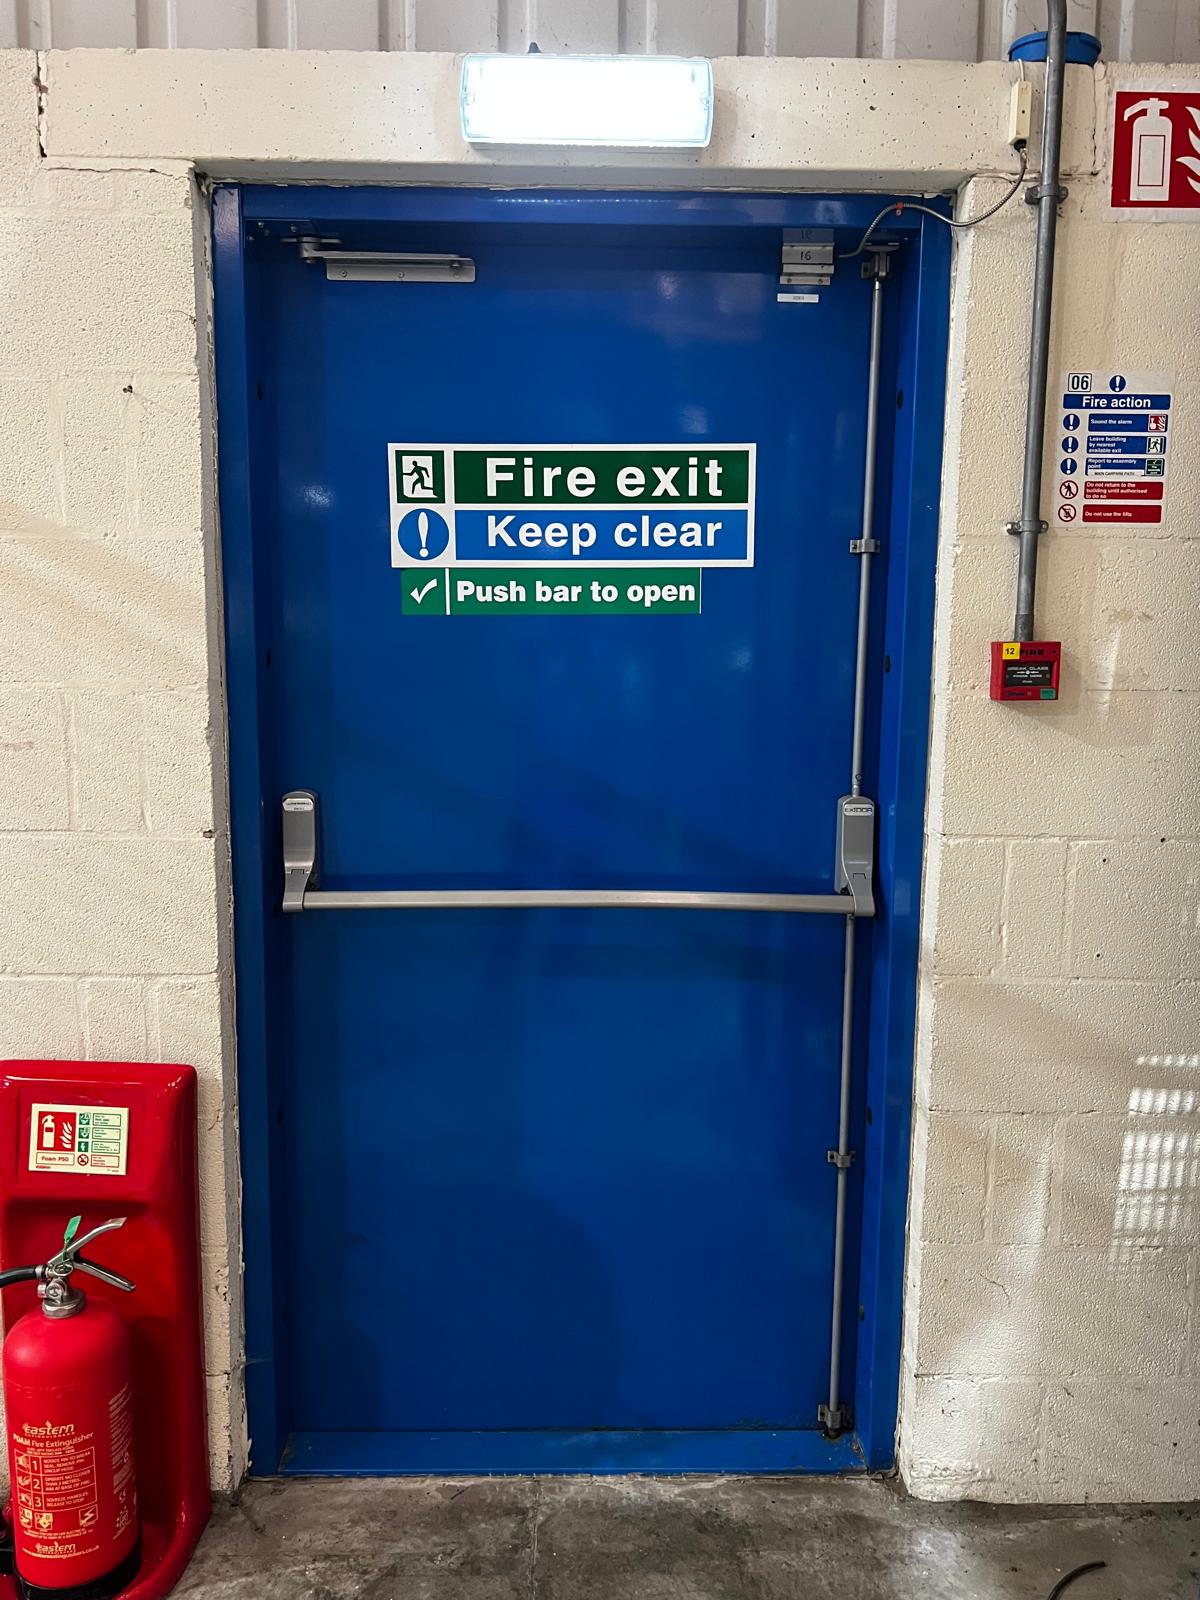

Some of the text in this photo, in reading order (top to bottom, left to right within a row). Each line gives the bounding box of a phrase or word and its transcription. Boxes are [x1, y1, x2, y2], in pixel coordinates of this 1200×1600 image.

[1072, 375, 1090, 390] 06
[1082, 396, 1151, 408] Fire action
[486, 457, 723, 497] Fire exit
[488, 515, 722, 556] Keep clear
[456, 580, 696, 607] Push bar to open
[24, 1422, 74, 1435] eastern
[46, 1432, 93, 1448] Extinguisher
[33, 1461, 37, 1470] 1
[33, 1479, 40, 1489] 2
[35, 1497, 41, 1506] 3
